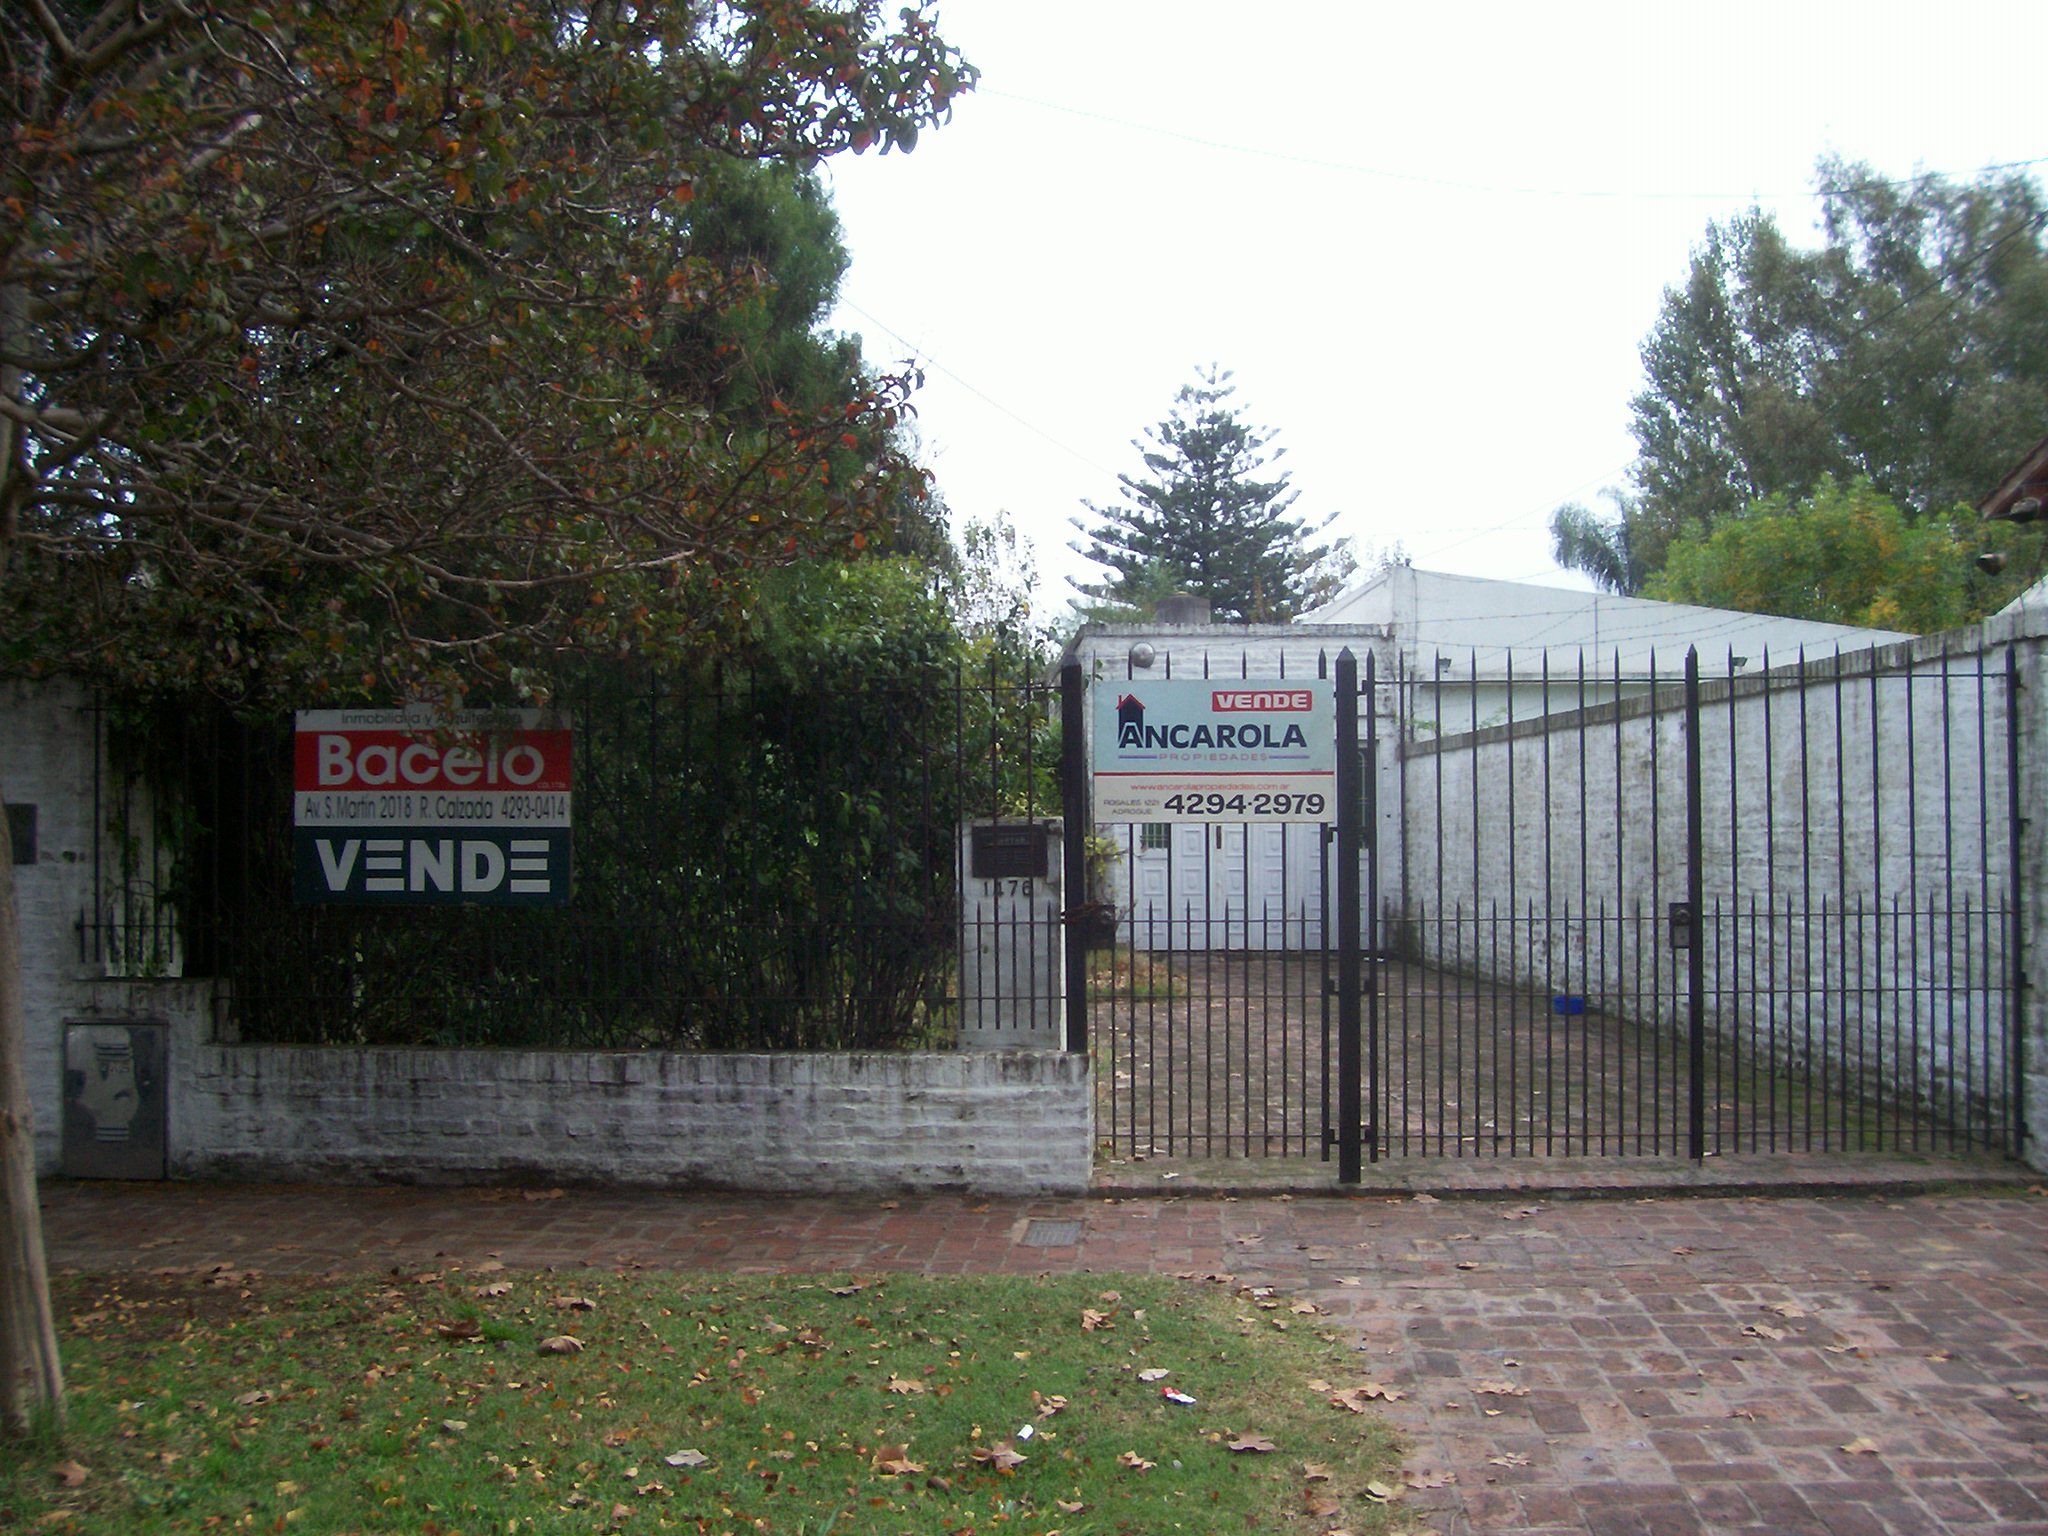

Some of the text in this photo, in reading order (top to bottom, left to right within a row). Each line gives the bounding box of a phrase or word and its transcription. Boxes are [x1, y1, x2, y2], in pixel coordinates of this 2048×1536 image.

[1216, 693, 1308, 709] VENDE
[1118, 723, 1307, 749] ANCAROLA
[318, 734, 545, 785] Bacelo
[1158, 753, 1268, 761] PROPIEDADES
[380, 796, 412, 819] 2018
[419, 796, 431, 819] R.
[435, 795, 493, 819] Calzada
[501, 796, 565, 819] 4293-0414
[315, 839, 551, 893] VENDE
